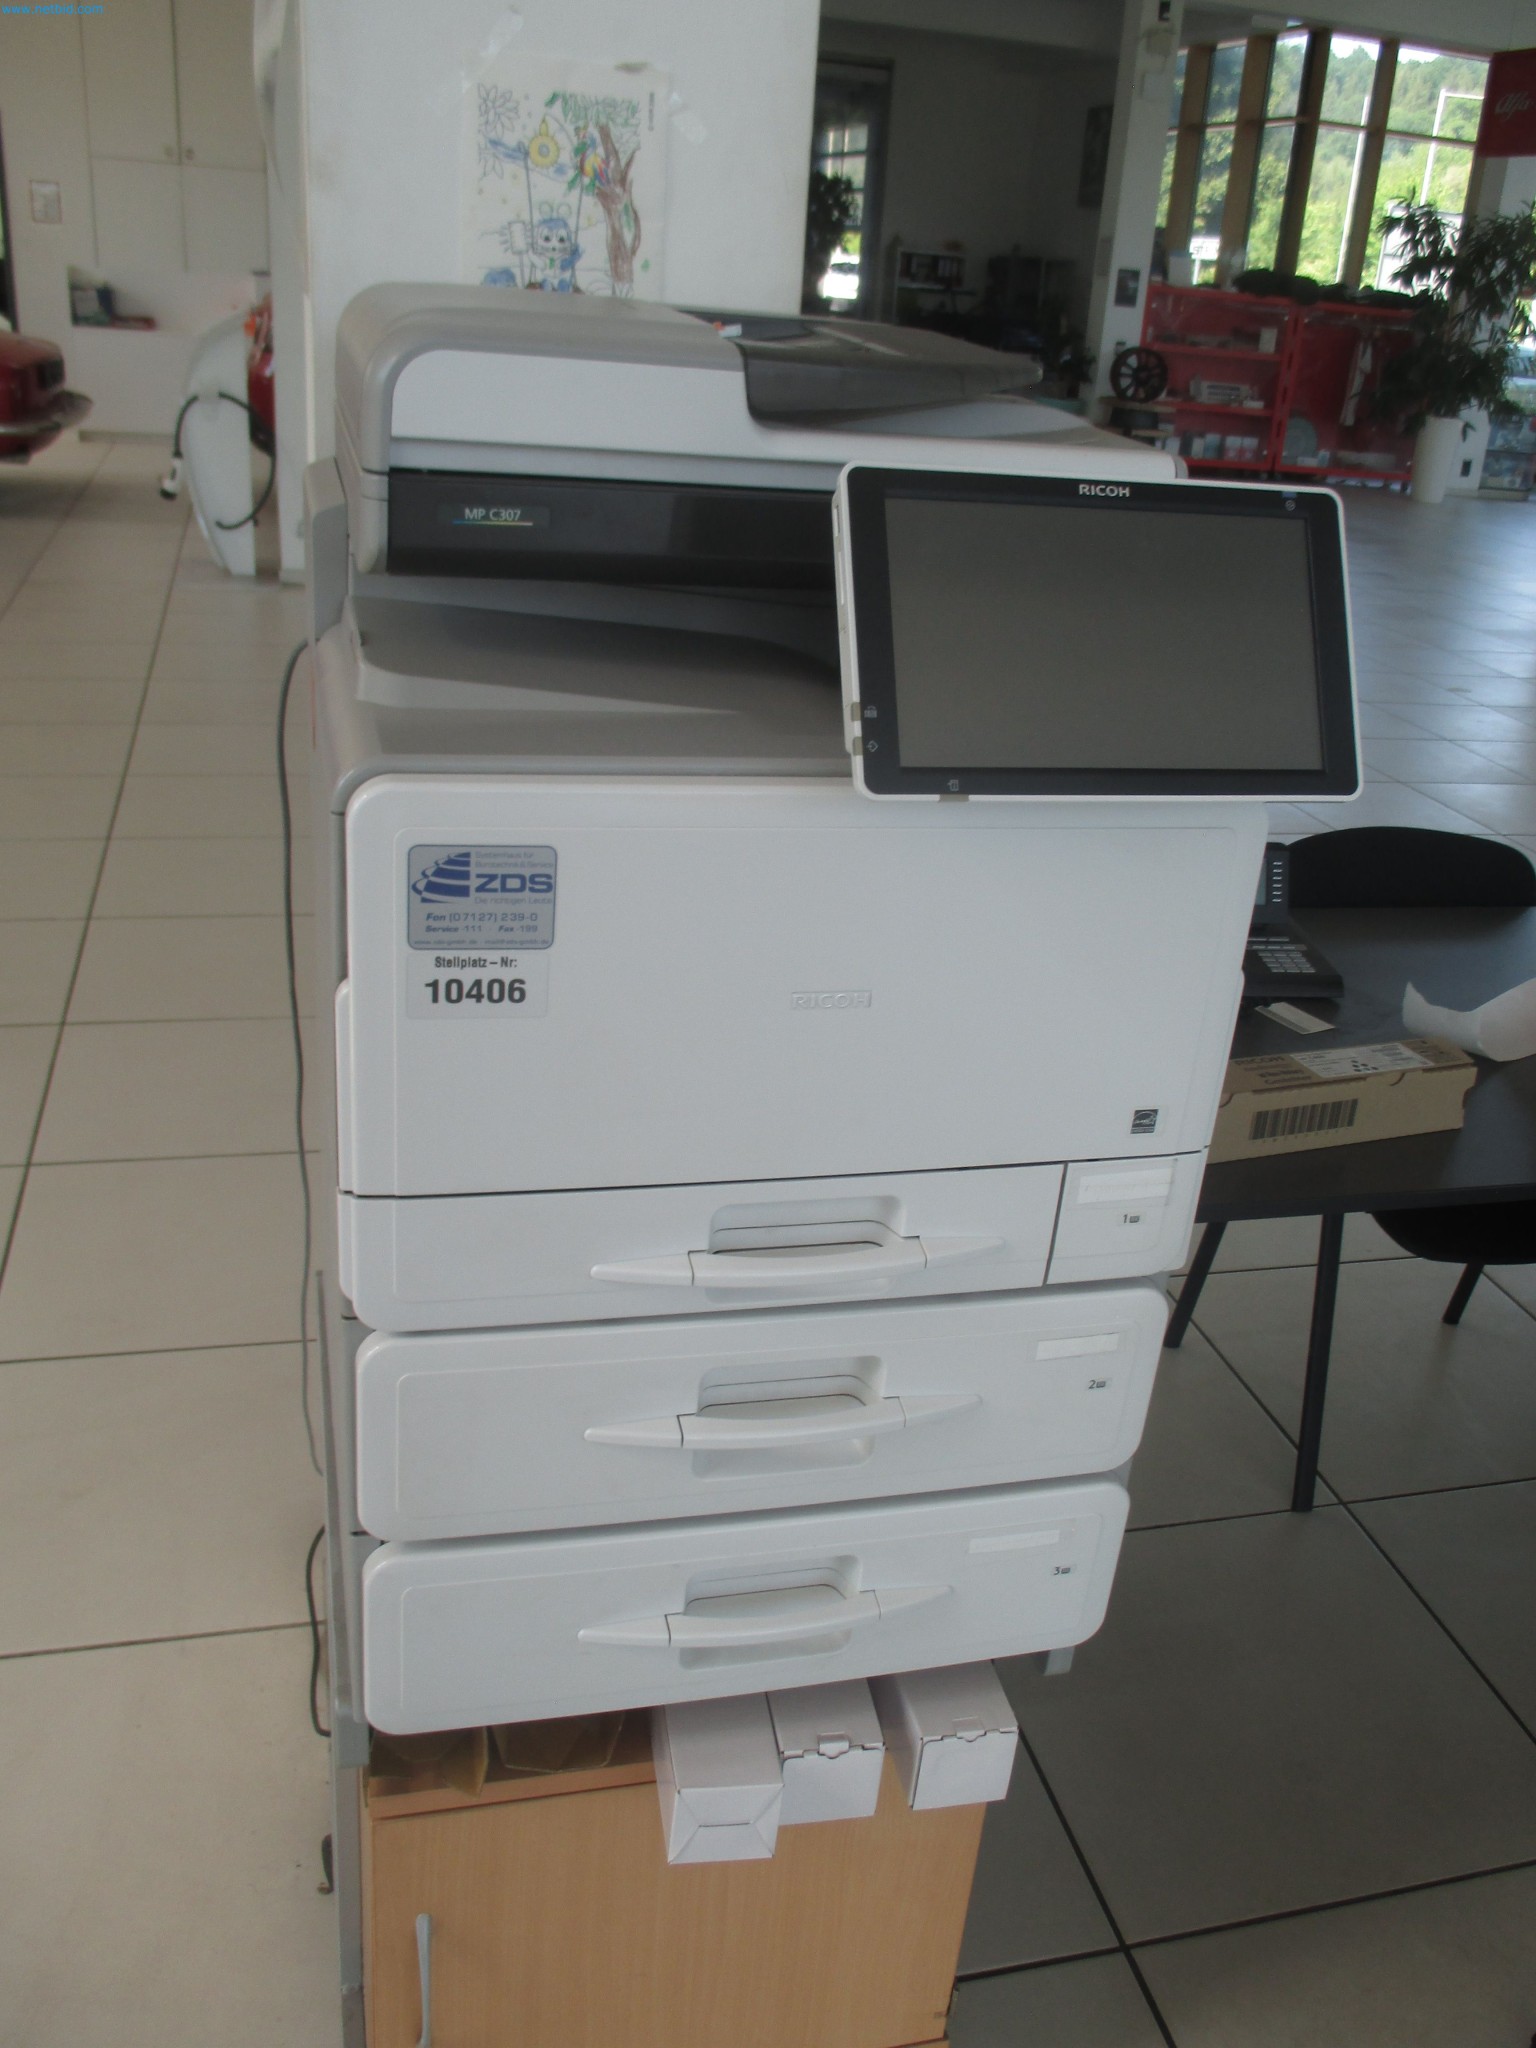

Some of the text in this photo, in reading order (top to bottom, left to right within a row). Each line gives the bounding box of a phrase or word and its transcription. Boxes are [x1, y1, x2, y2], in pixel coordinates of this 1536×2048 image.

[1078, 483, 1131, 498] RICOH
[464, 507, 521, 521] MP C307
[475, 873, 553, 893] ZDS
[426, 912, 446, 921] Fon
[425, 925, 459, 933] Service
[498, 925, 514, 933] Fax
[434, 956, 488, 970] Stellplatz
[424, 978, 527, 1004] 10406
[791, 991, 872, 1009] RICOH
[1088, 1379, 1096, 1390] 2
[1053, 1566, 1061, 1576] 3
